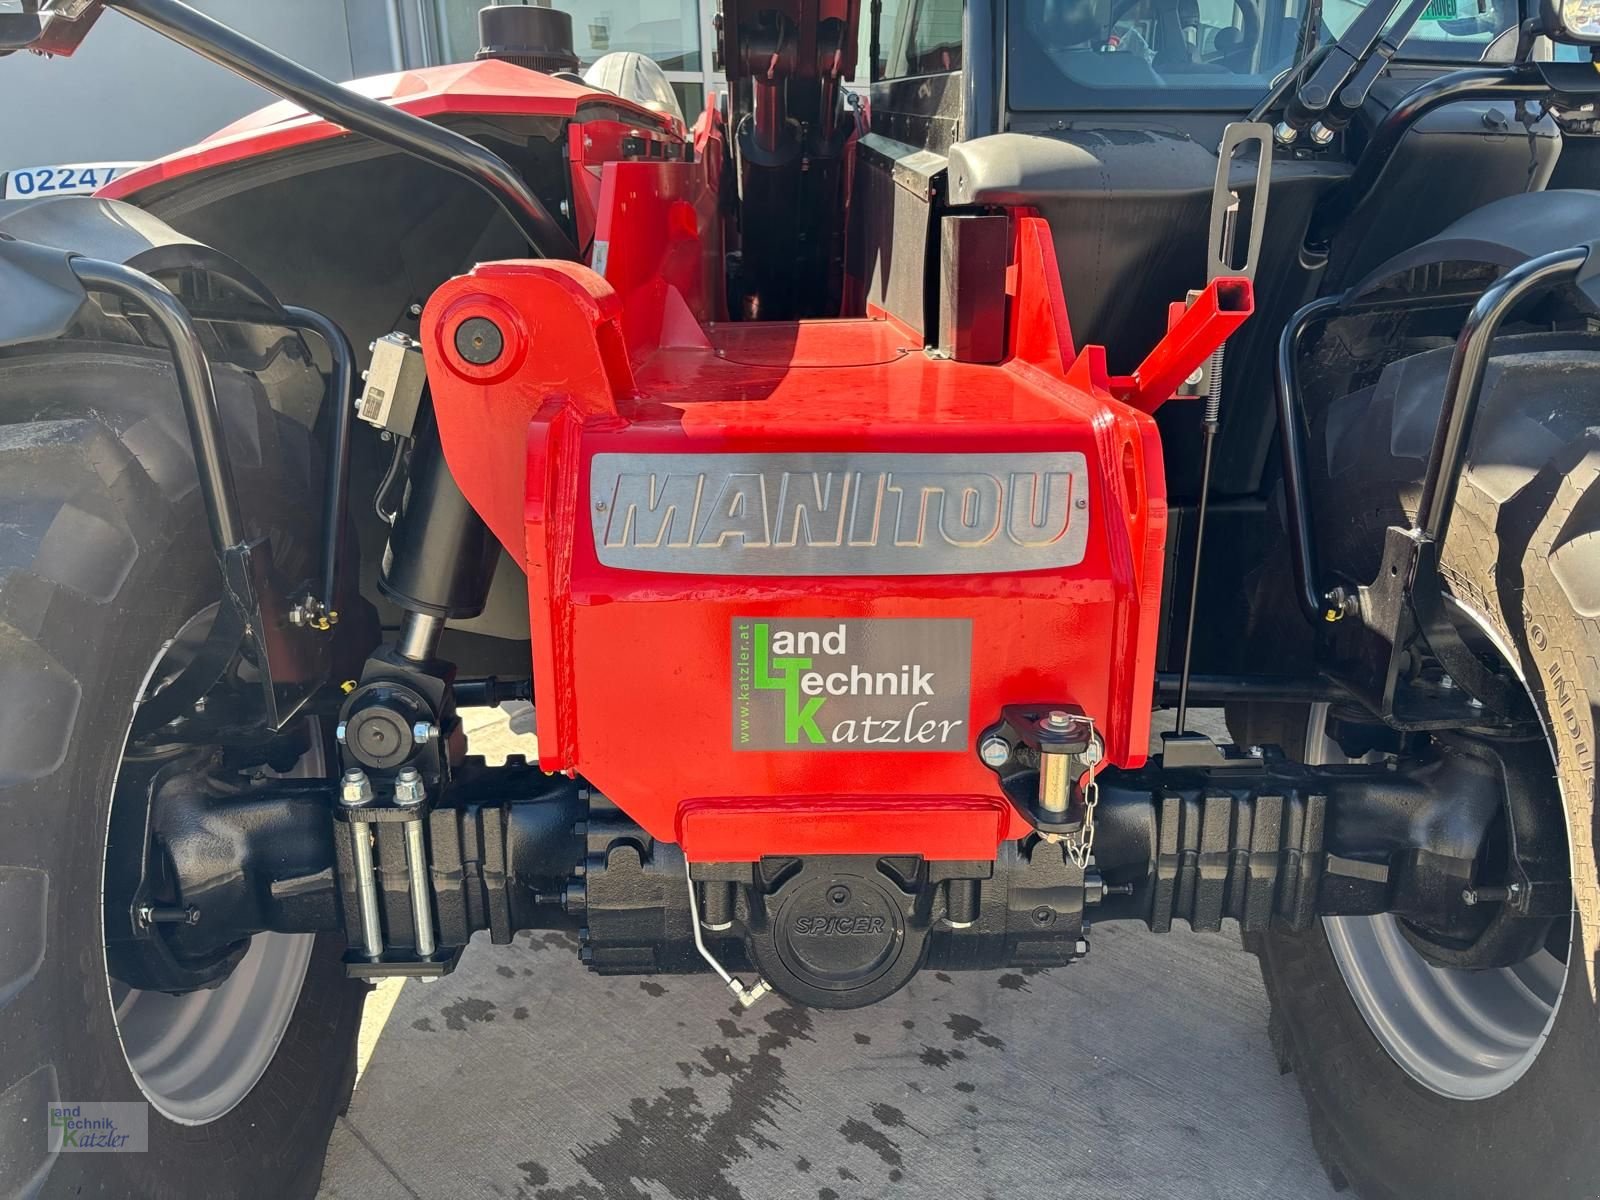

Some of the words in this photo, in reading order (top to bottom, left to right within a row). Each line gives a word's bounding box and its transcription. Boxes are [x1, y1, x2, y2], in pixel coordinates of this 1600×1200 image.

[604, 472, 1073, 547] MANITOU
[737, 624, 750, 744] www.katzler.at
[754, 624, 847, 689] Land
[773, 657, 935, 703] Technik
[784, 697, 963, 744] Katzler
[793, 916, 885, 936] SPICER
